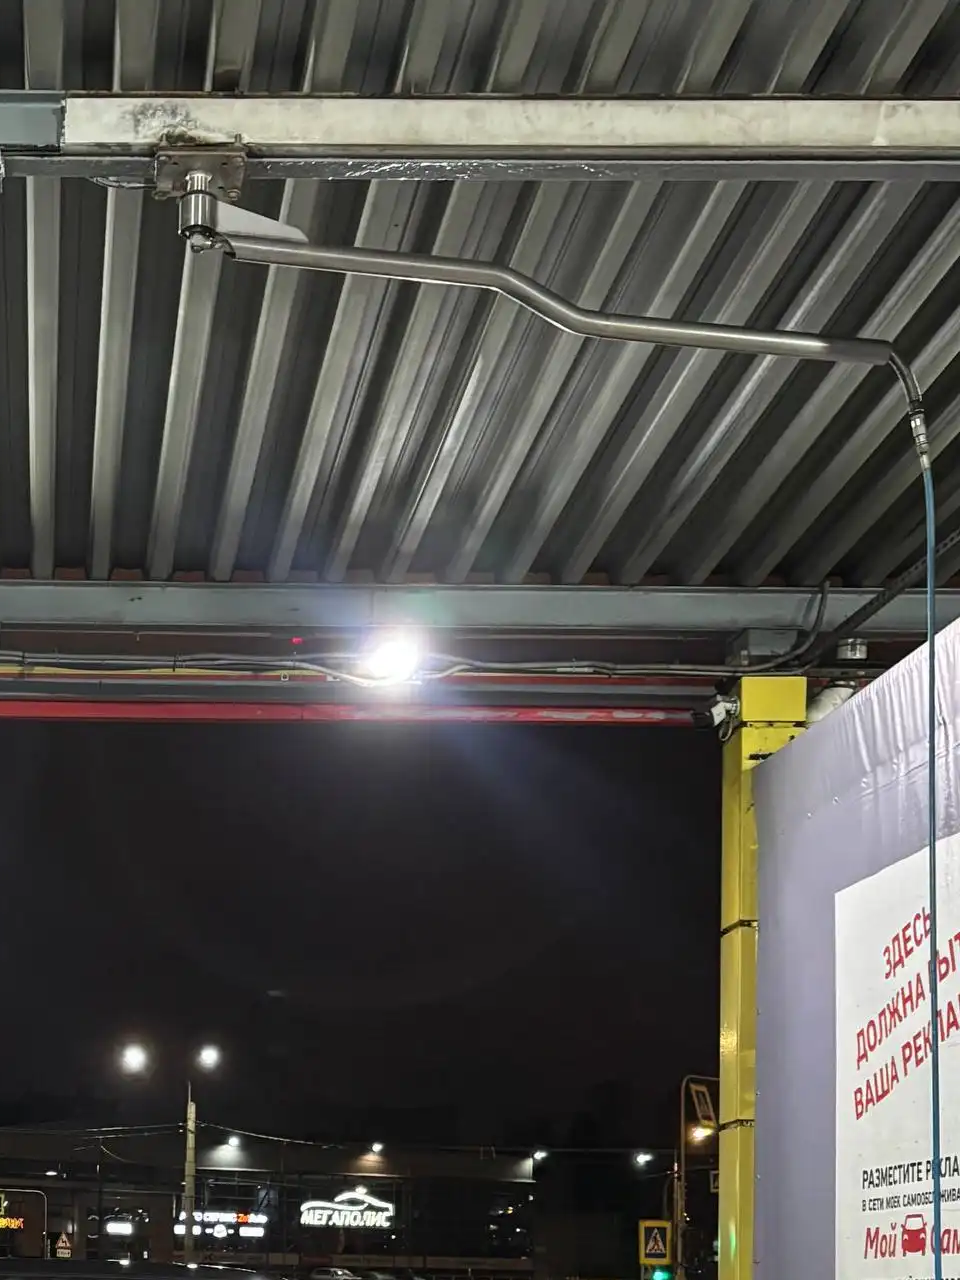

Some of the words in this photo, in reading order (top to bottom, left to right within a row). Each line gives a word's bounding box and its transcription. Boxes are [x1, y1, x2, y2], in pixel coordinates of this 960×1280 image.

[883, 907, 932, 979] ЗДЕСЬ
[856, 972, 926, 1070] ДОЛЖНА
[854, 1056, 900, 1121] ВАША
[901, 995, 960, 1077] РЕКЛА
[862, 1161, 922, 1190] РАЗМЕСТИТЕ
[300, 1209, 392, 1227] МЕГАПОЛИС
[861, 1199, 867, 1212] В
[868, 1197, 884, 1211] СЕТИ
[886, 1195, 901, 1210] МОЕК
[864, 1222, 897, 1259] Мой
